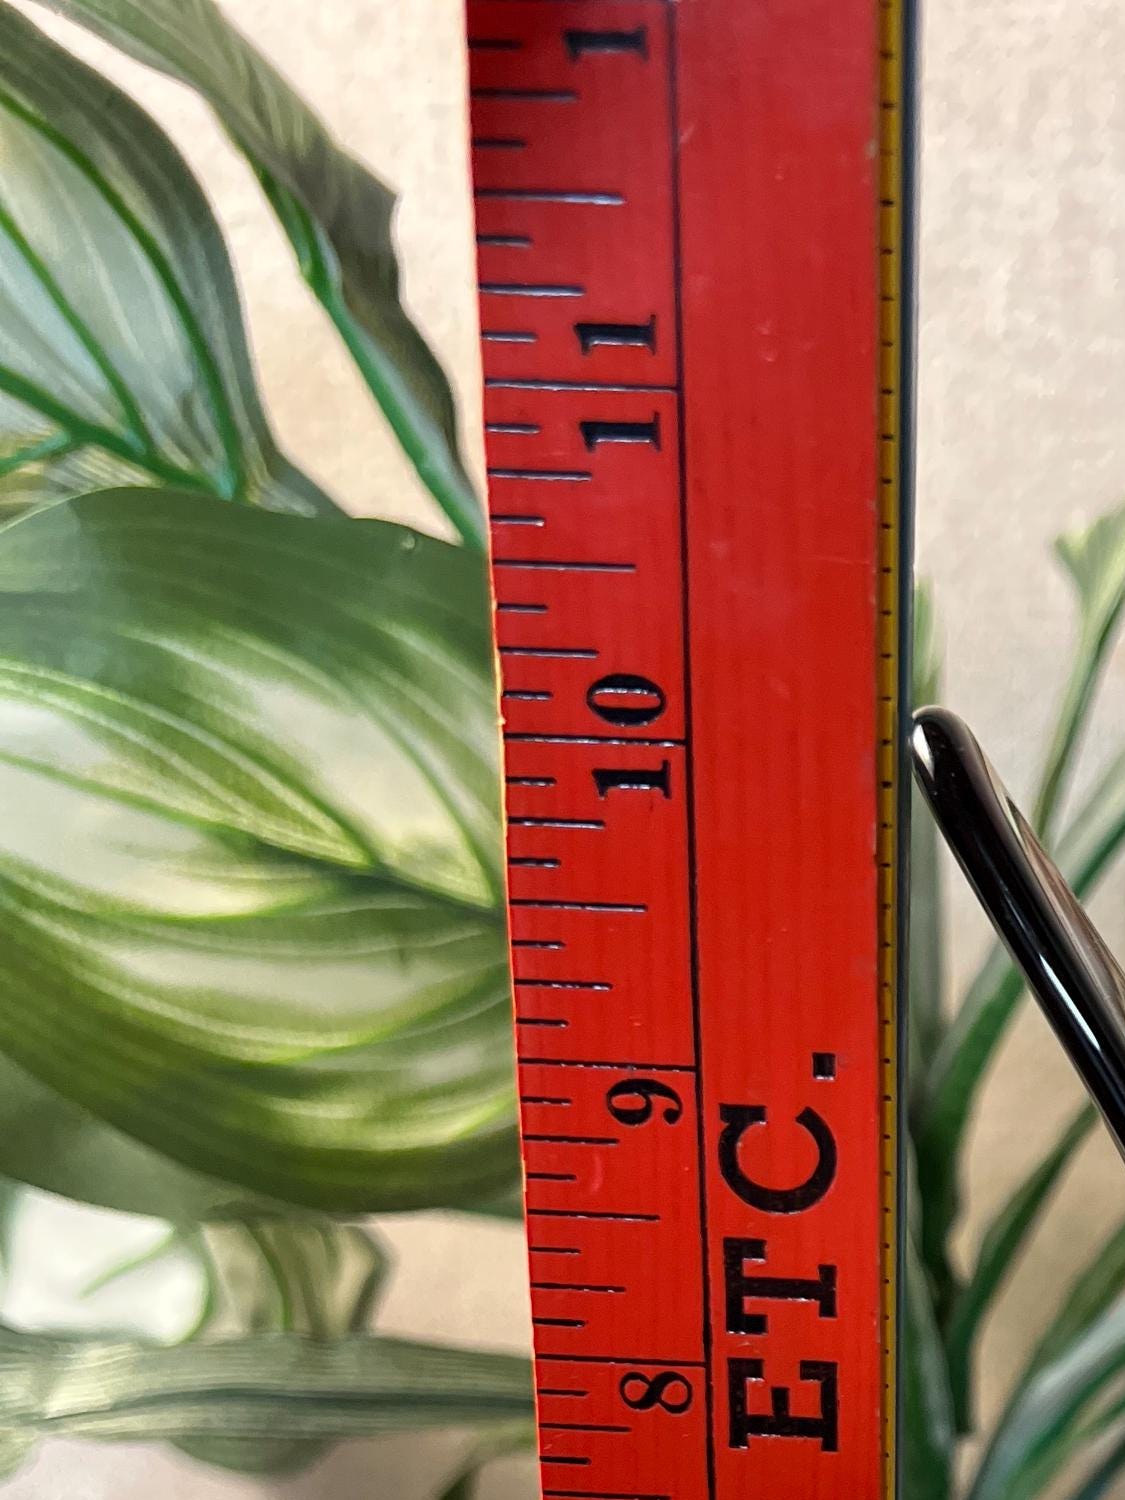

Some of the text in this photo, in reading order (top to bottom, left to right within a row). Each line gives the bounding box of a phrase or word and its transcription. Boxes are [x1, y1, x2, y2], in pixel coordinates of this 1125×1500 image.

[573, 313, 661, 452] 11
[587, 672, 672, 800] 10
[606, 1077, 684, 1127] 9
[718, 1052, 838, 1453] ETC.
[619, 1371, 693, 1414] 8
